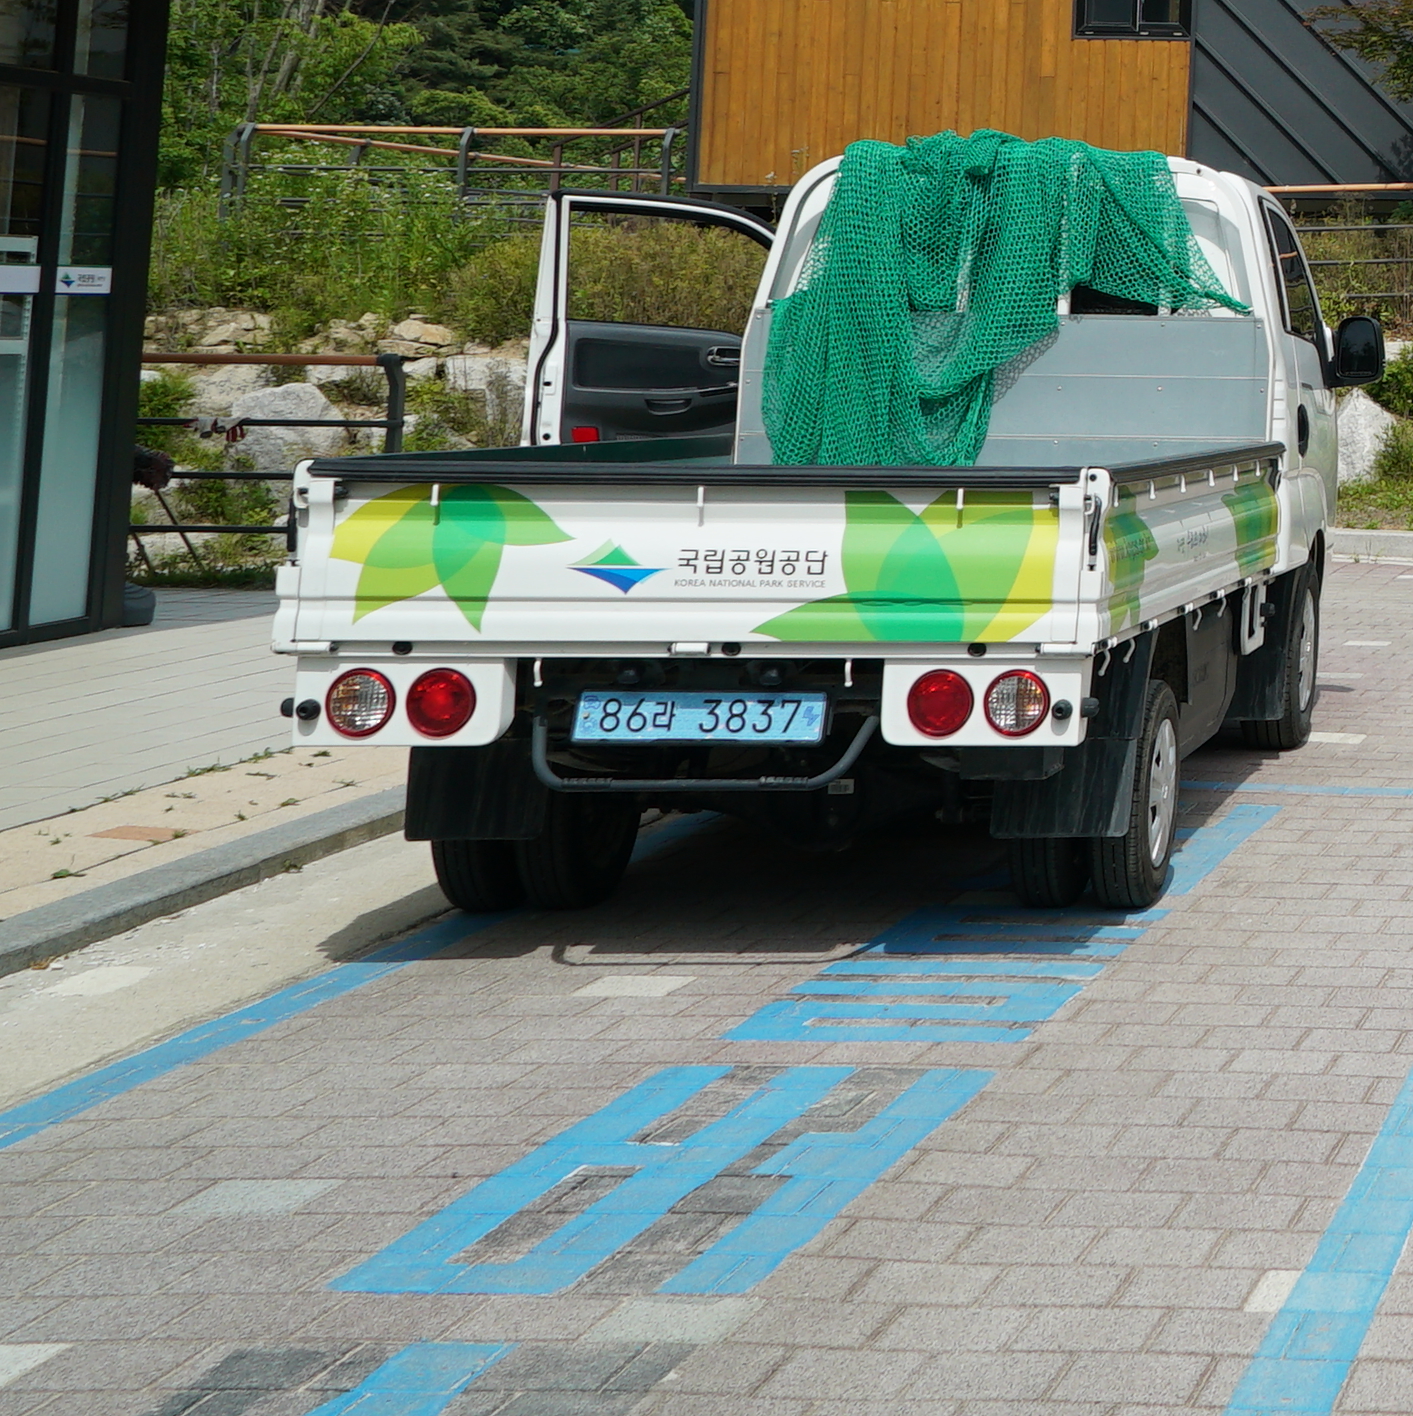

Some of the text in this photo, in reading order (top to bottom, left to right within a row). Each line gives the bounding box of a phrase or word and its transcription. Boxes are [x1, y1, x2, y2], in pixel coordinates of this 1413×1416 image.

[677, 548, 829, 576] 국립공원공단
[674, 578, 826, 589] KOREA NATIONAL PARK SERVICE
[600, 697, 802, 734] 86라 3837
